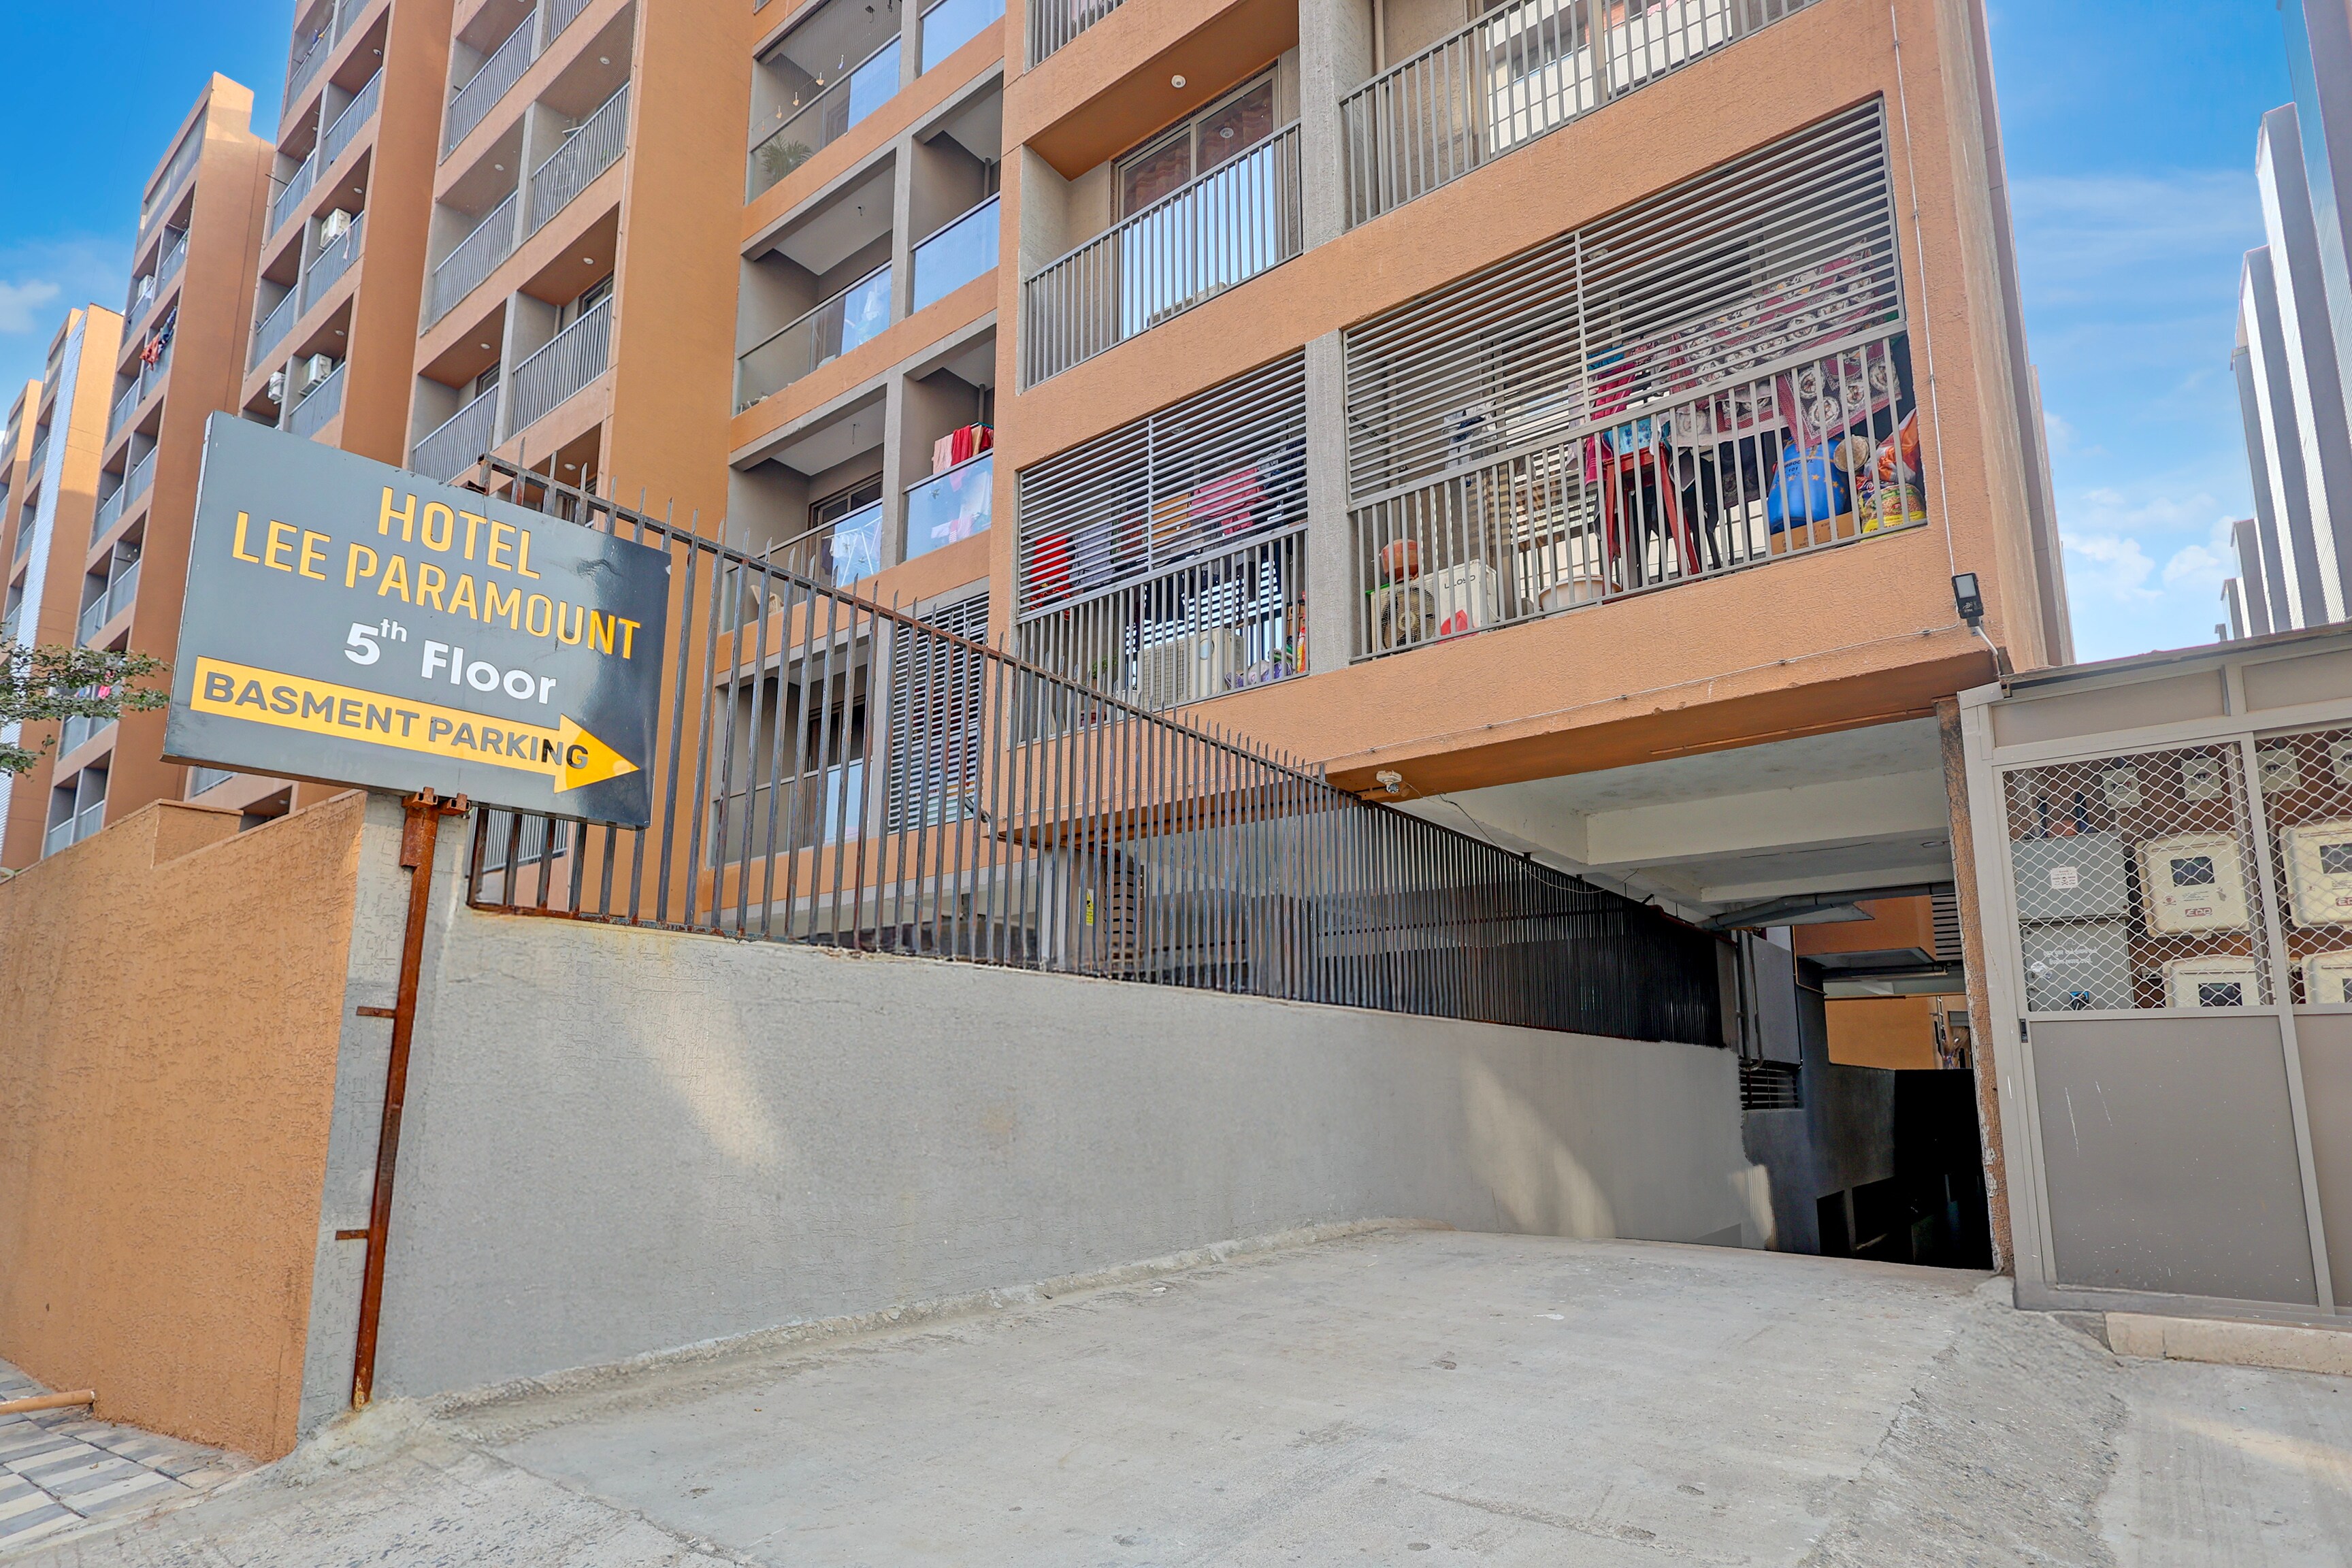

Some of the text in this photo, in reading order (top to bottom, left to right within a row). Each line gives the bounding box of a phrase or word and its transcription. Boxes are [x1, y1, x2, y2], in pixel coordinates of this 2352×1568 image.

[378, 486, 540, 580] HOTEL
[231, 510, 641, 659] LEE PARAMOUNT
[344, 618, 557, 705] 5th Floor
[203, 671, 589, 770] BASMENT PARKING
